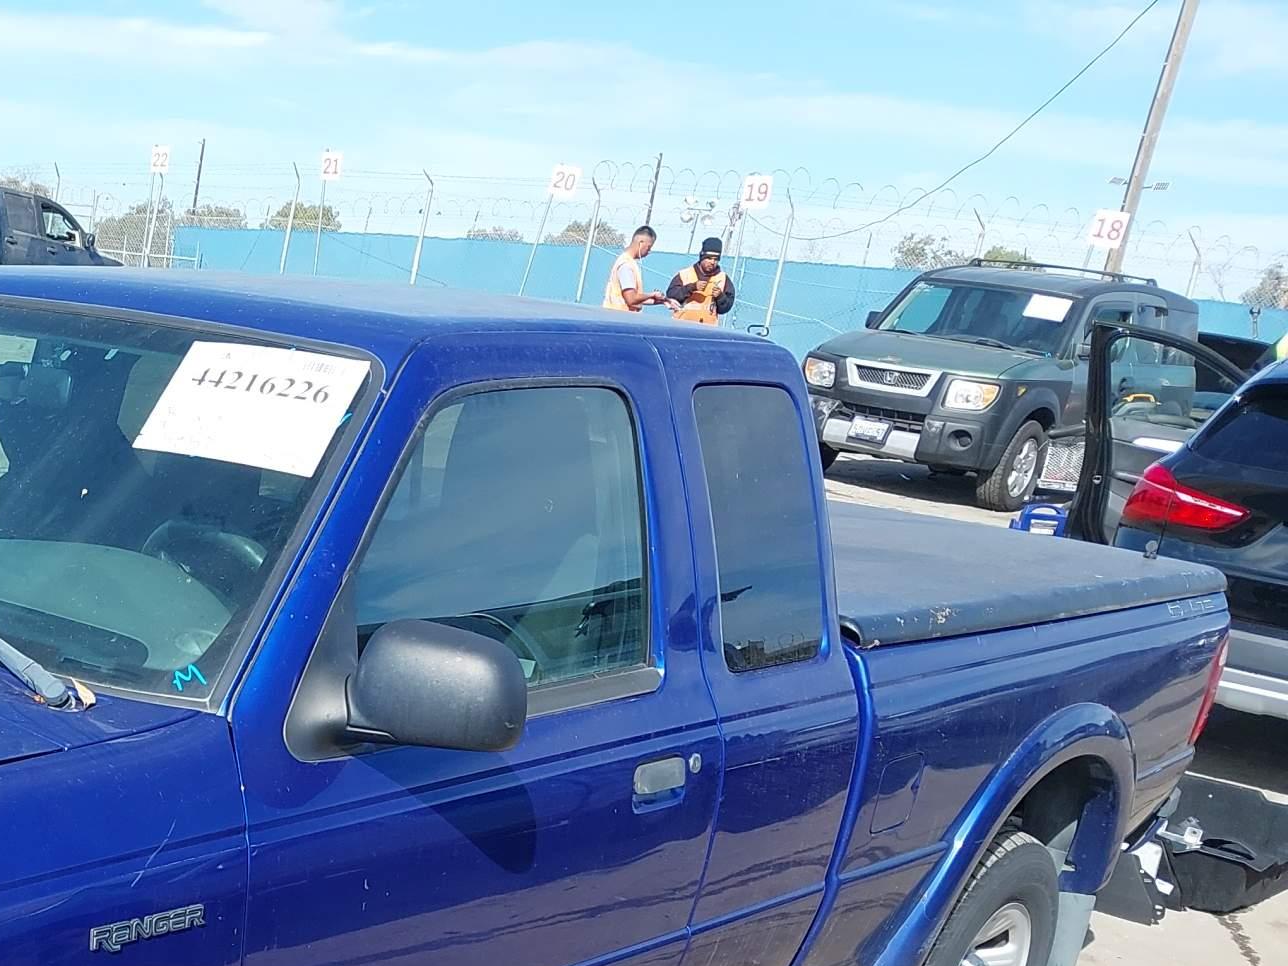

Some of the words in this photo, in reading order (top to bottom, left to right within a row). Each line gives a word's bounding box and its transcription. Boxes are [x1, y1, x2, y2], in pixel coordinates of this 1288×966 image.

[152, 152, 168, 167] 22
[323, 158, 339, 174] 21
[553, 171, 575, 191] 20
[744, 182, 769, 202] 19
[1092, 218, 1124, 241] 18
[191, 367, 330, 404] 44216226
[90, 903, 206, 952] RANGER
